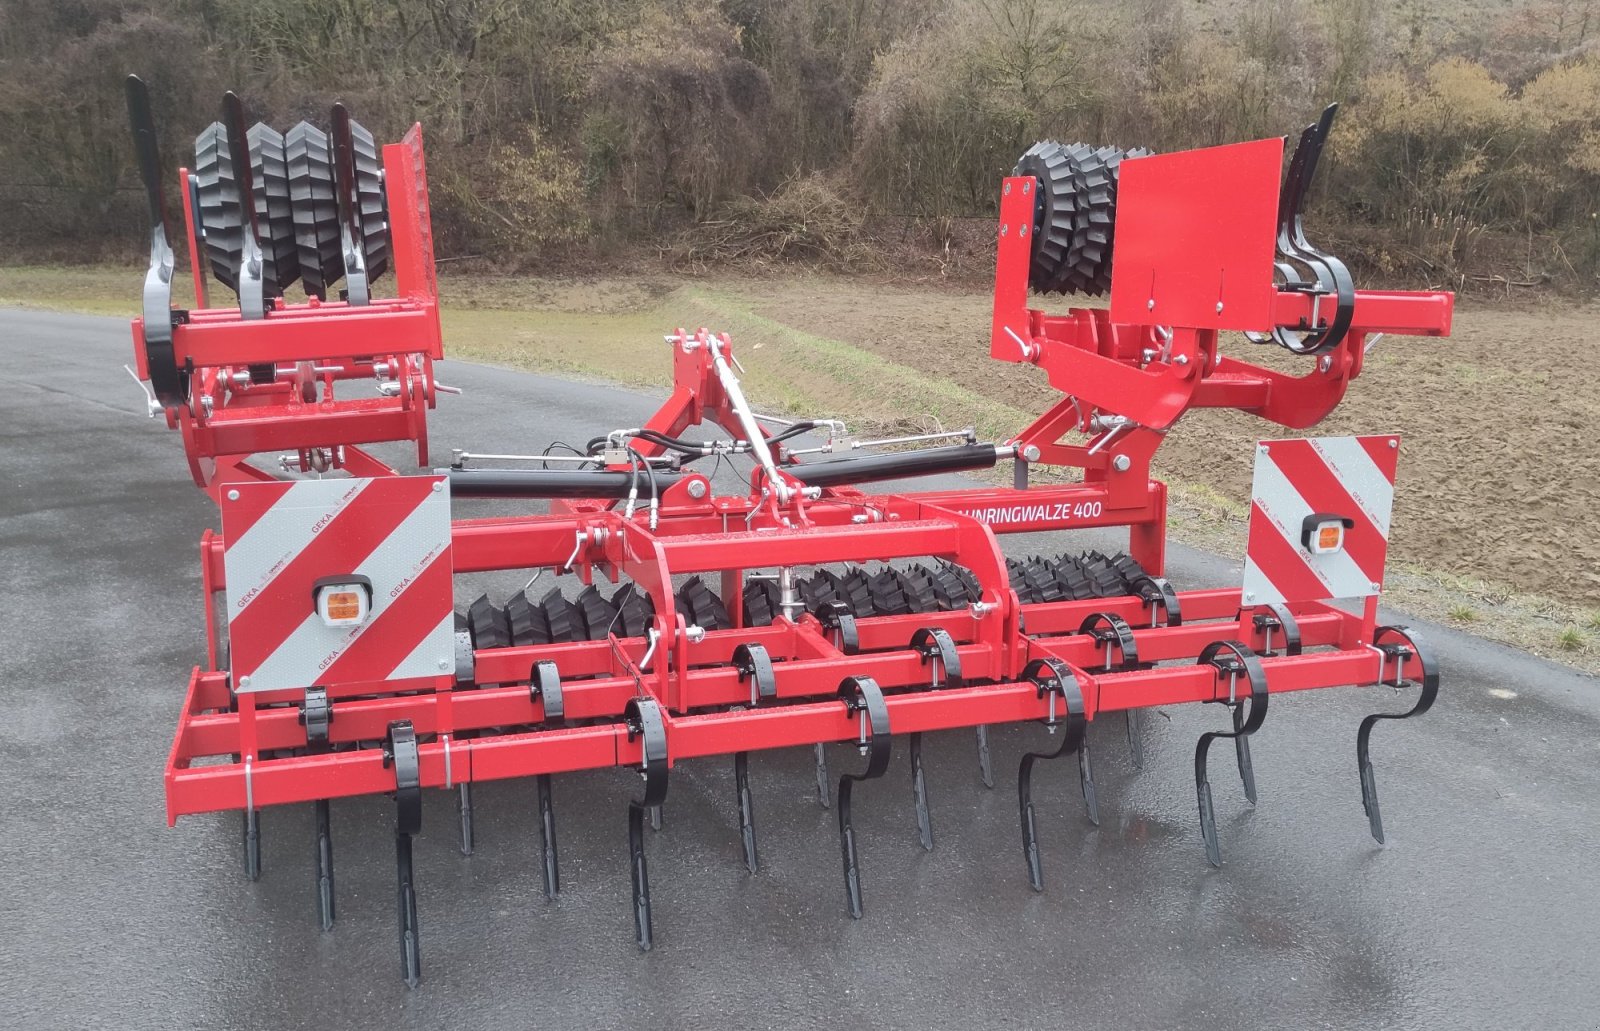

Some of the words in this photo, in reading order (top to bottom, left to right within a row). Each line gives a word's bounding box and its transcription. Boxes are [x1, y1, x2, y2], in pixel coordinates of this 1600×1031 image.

[1312, 440, 1323, 454] GEKA
[1257, 497, 1269, 512] GEKA
[1353, 492, 1364, 506] GEKA
[957, 504, 1071, 523] NRINGWALZE
[1074, 502, 1101, 518] 400
[311, 513, 333, 534] GEKA
[1300, 549, 1312, 564] GEKA
[237, 587, 258, 608] GEKA
[390, 578, 410, 598] GEKA
[318, 650, 339, 670] GEKA
